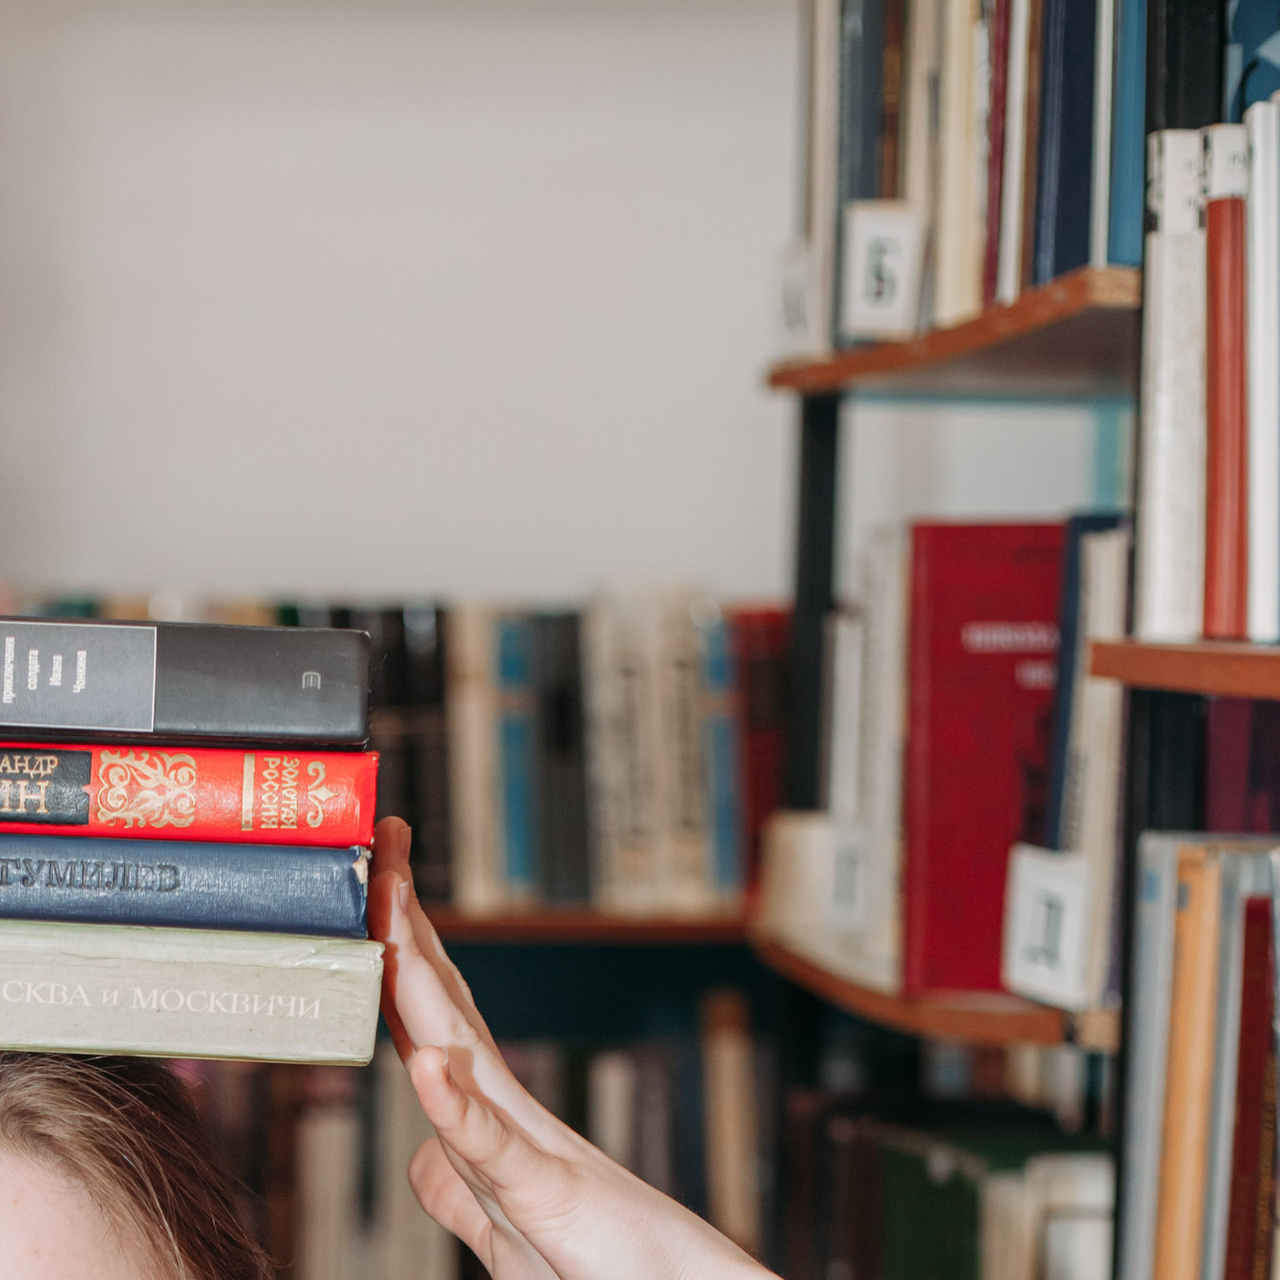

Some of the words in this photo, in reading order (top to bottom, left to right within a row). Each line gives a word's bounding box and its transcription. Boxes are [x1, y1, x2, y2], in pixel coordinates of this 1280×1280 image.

[2, 635, 16, 704] приключения
[27, 648, 40, 691] солдата
[48, 654, 63, 687] Ивана
[72, 649, 87, 694] Чонкина
[260, 756, 280, 829] РОССИЯ
[280, 755, 300, 830] ЗОЛОТАЯ
[101, 988, 120, 1007] и
[130, 987, 321, 1020] МОСКВИЧИ
